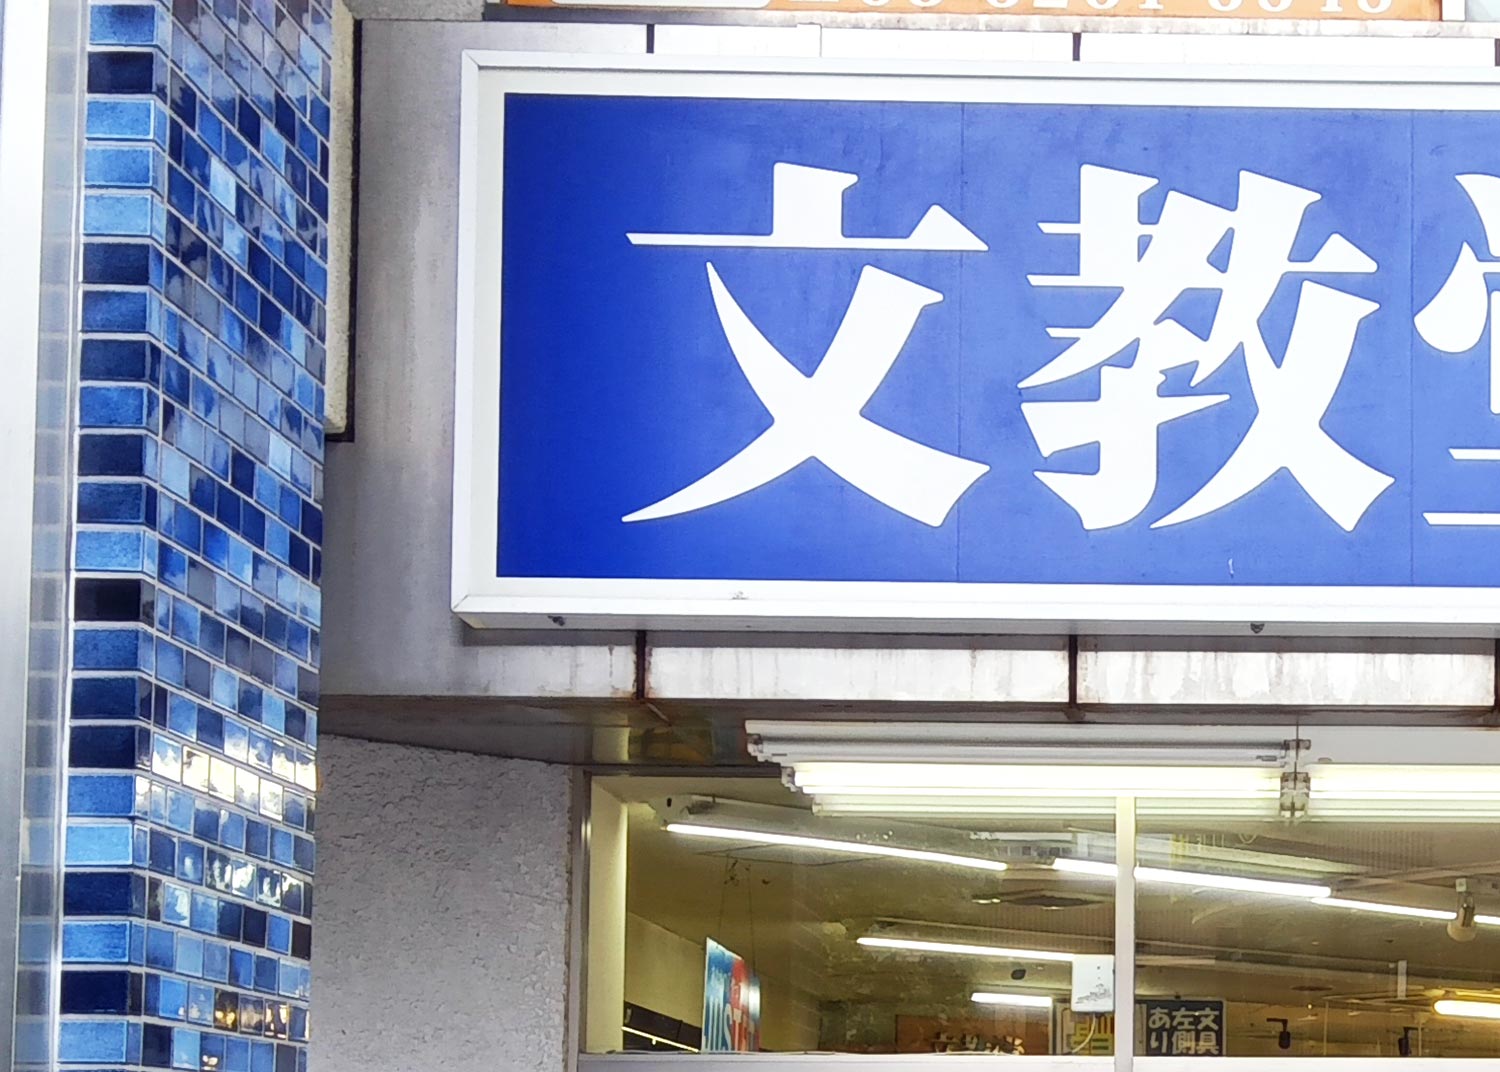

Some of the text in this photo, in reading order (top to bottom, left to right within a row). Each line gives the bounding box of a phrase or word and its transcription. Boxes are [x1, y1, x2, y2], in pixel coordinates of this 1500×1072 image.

[1148, 1006, 1171, 1054] あり
[1171, 1007, 1196, 1055] 左側
[1197, 1007, 1219, 1055] 文具
